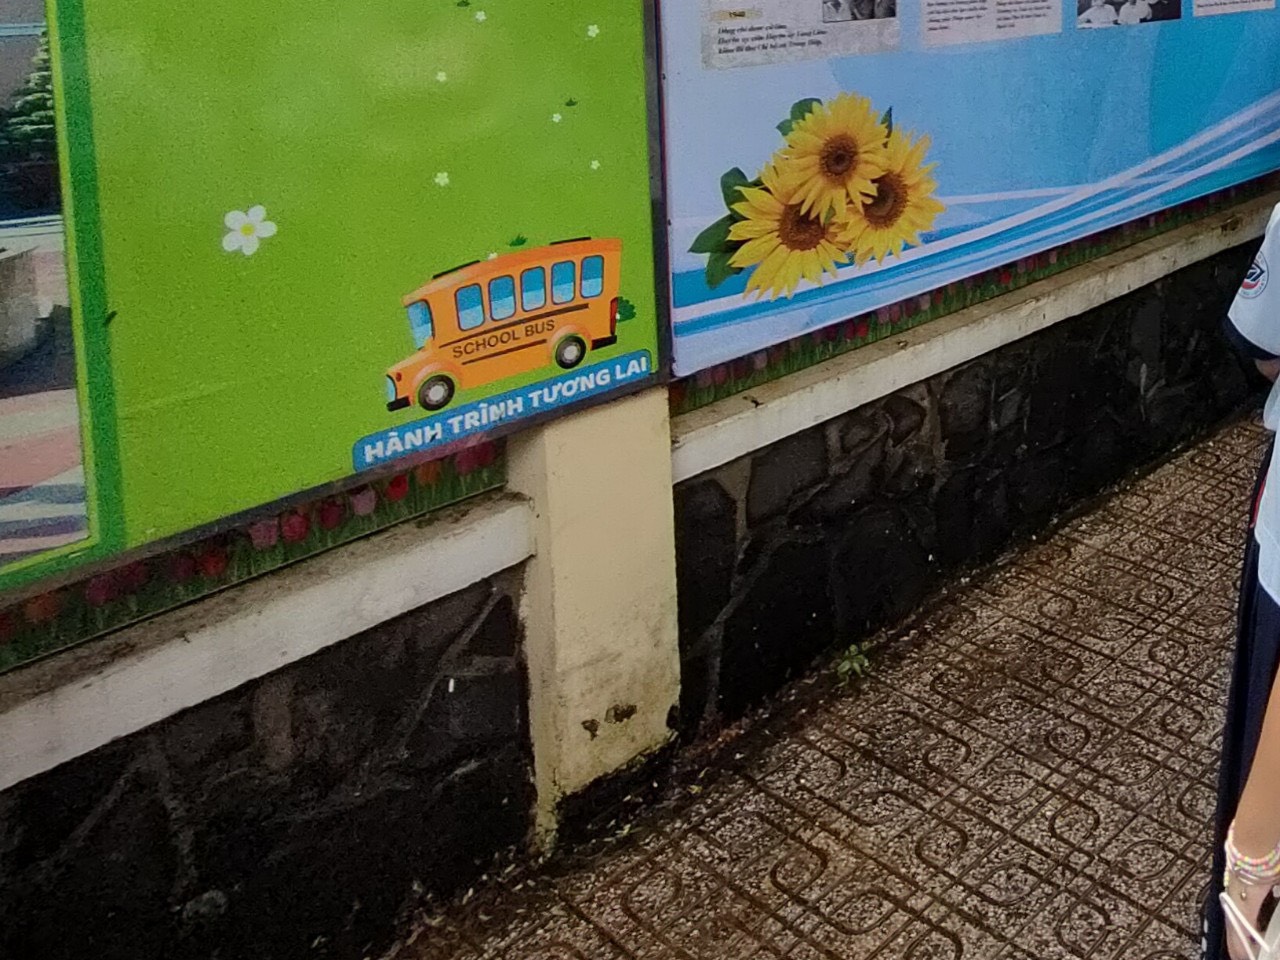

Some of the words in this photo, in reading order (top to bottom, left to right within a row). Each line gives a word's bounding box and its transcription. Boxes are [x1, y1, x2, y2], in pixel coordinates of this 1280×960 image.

[452, 329, 520, 359] SCHOOL
[524, 319, 556, 339] BUS
[364, 422, 442, 463] HÀNH
[447, 397, 523, 437] TRÌNH
[528, 369, 611, 408] TƯƠNG
[615, 356, 647, 378] LAI
